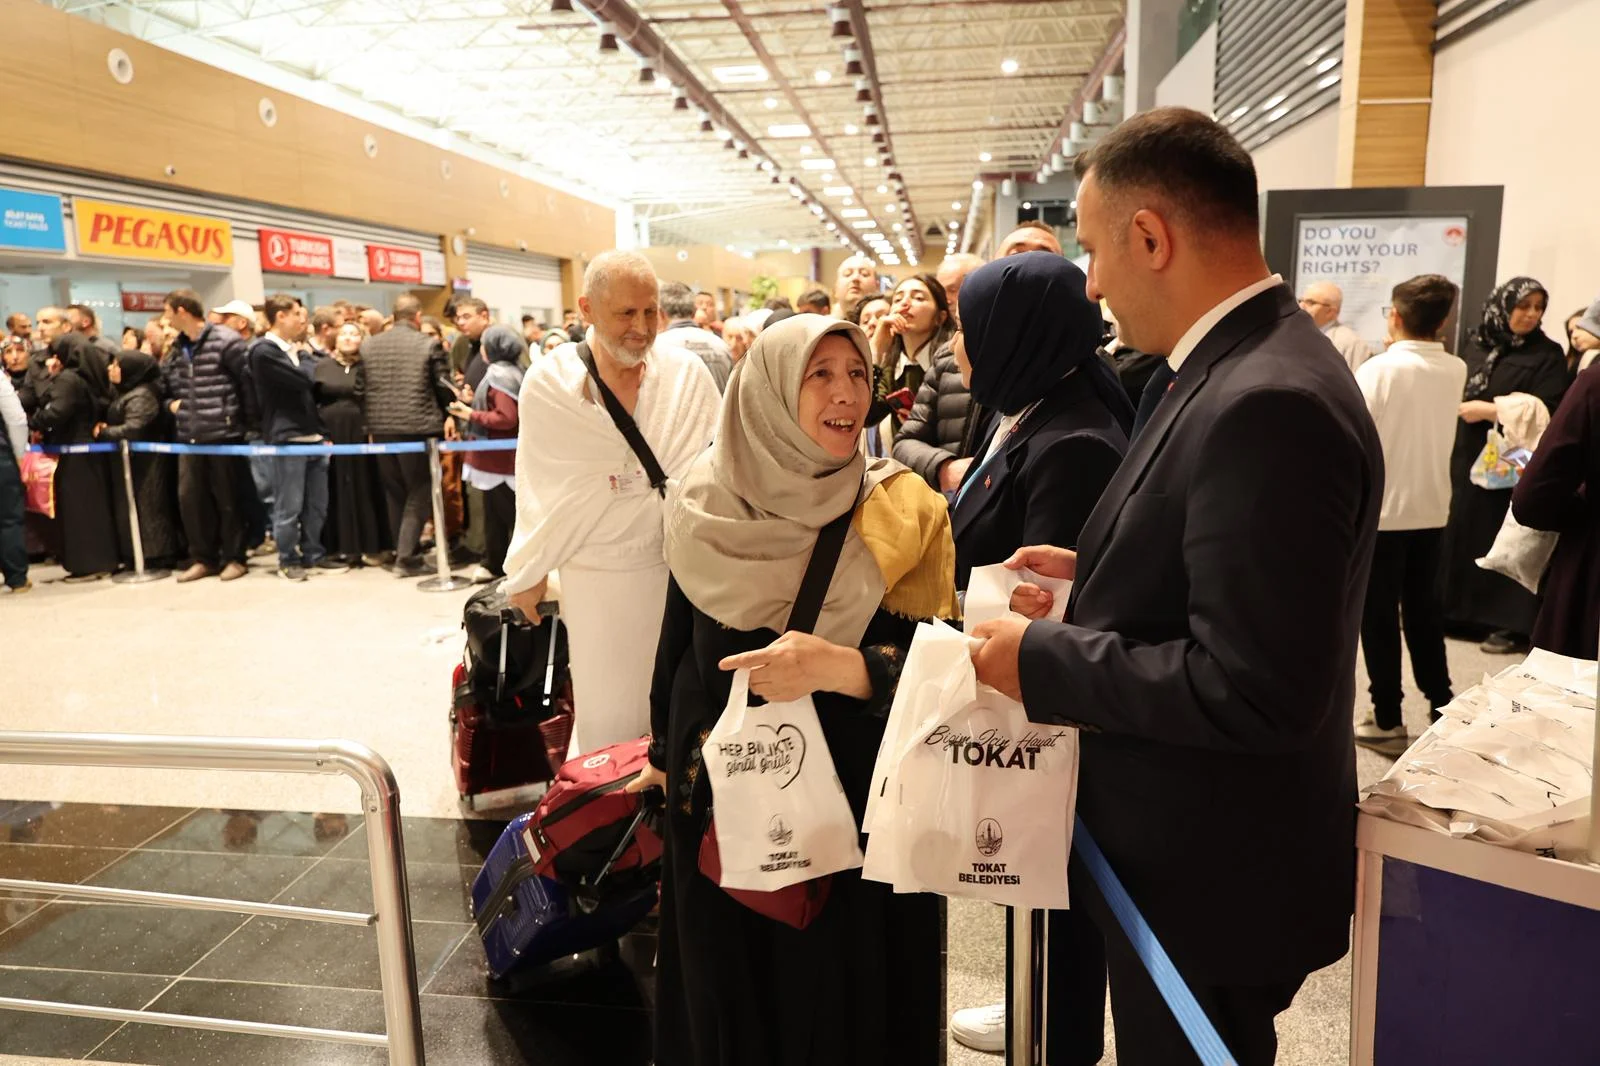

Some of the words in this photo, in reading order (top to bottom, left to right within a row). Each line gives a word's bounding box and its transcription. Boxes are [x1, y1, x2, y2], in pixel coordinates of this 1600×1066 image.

[89, 213, 225, 258] PEGASUS
[1304, 227, 1331, 240] DO
[1338, 226, 1377, 240] YOU
[1303, 244, 1360, 257] KNOW
[1367, 243, 1418, 256] YOUR
[1302, 261, 1380, 273] RIGHTS?
[1017, 731, 1067, 749] Hayat
[949, 740, 1041, 770] TOKAT
[972, 863, 1007, 873] TOKAT
